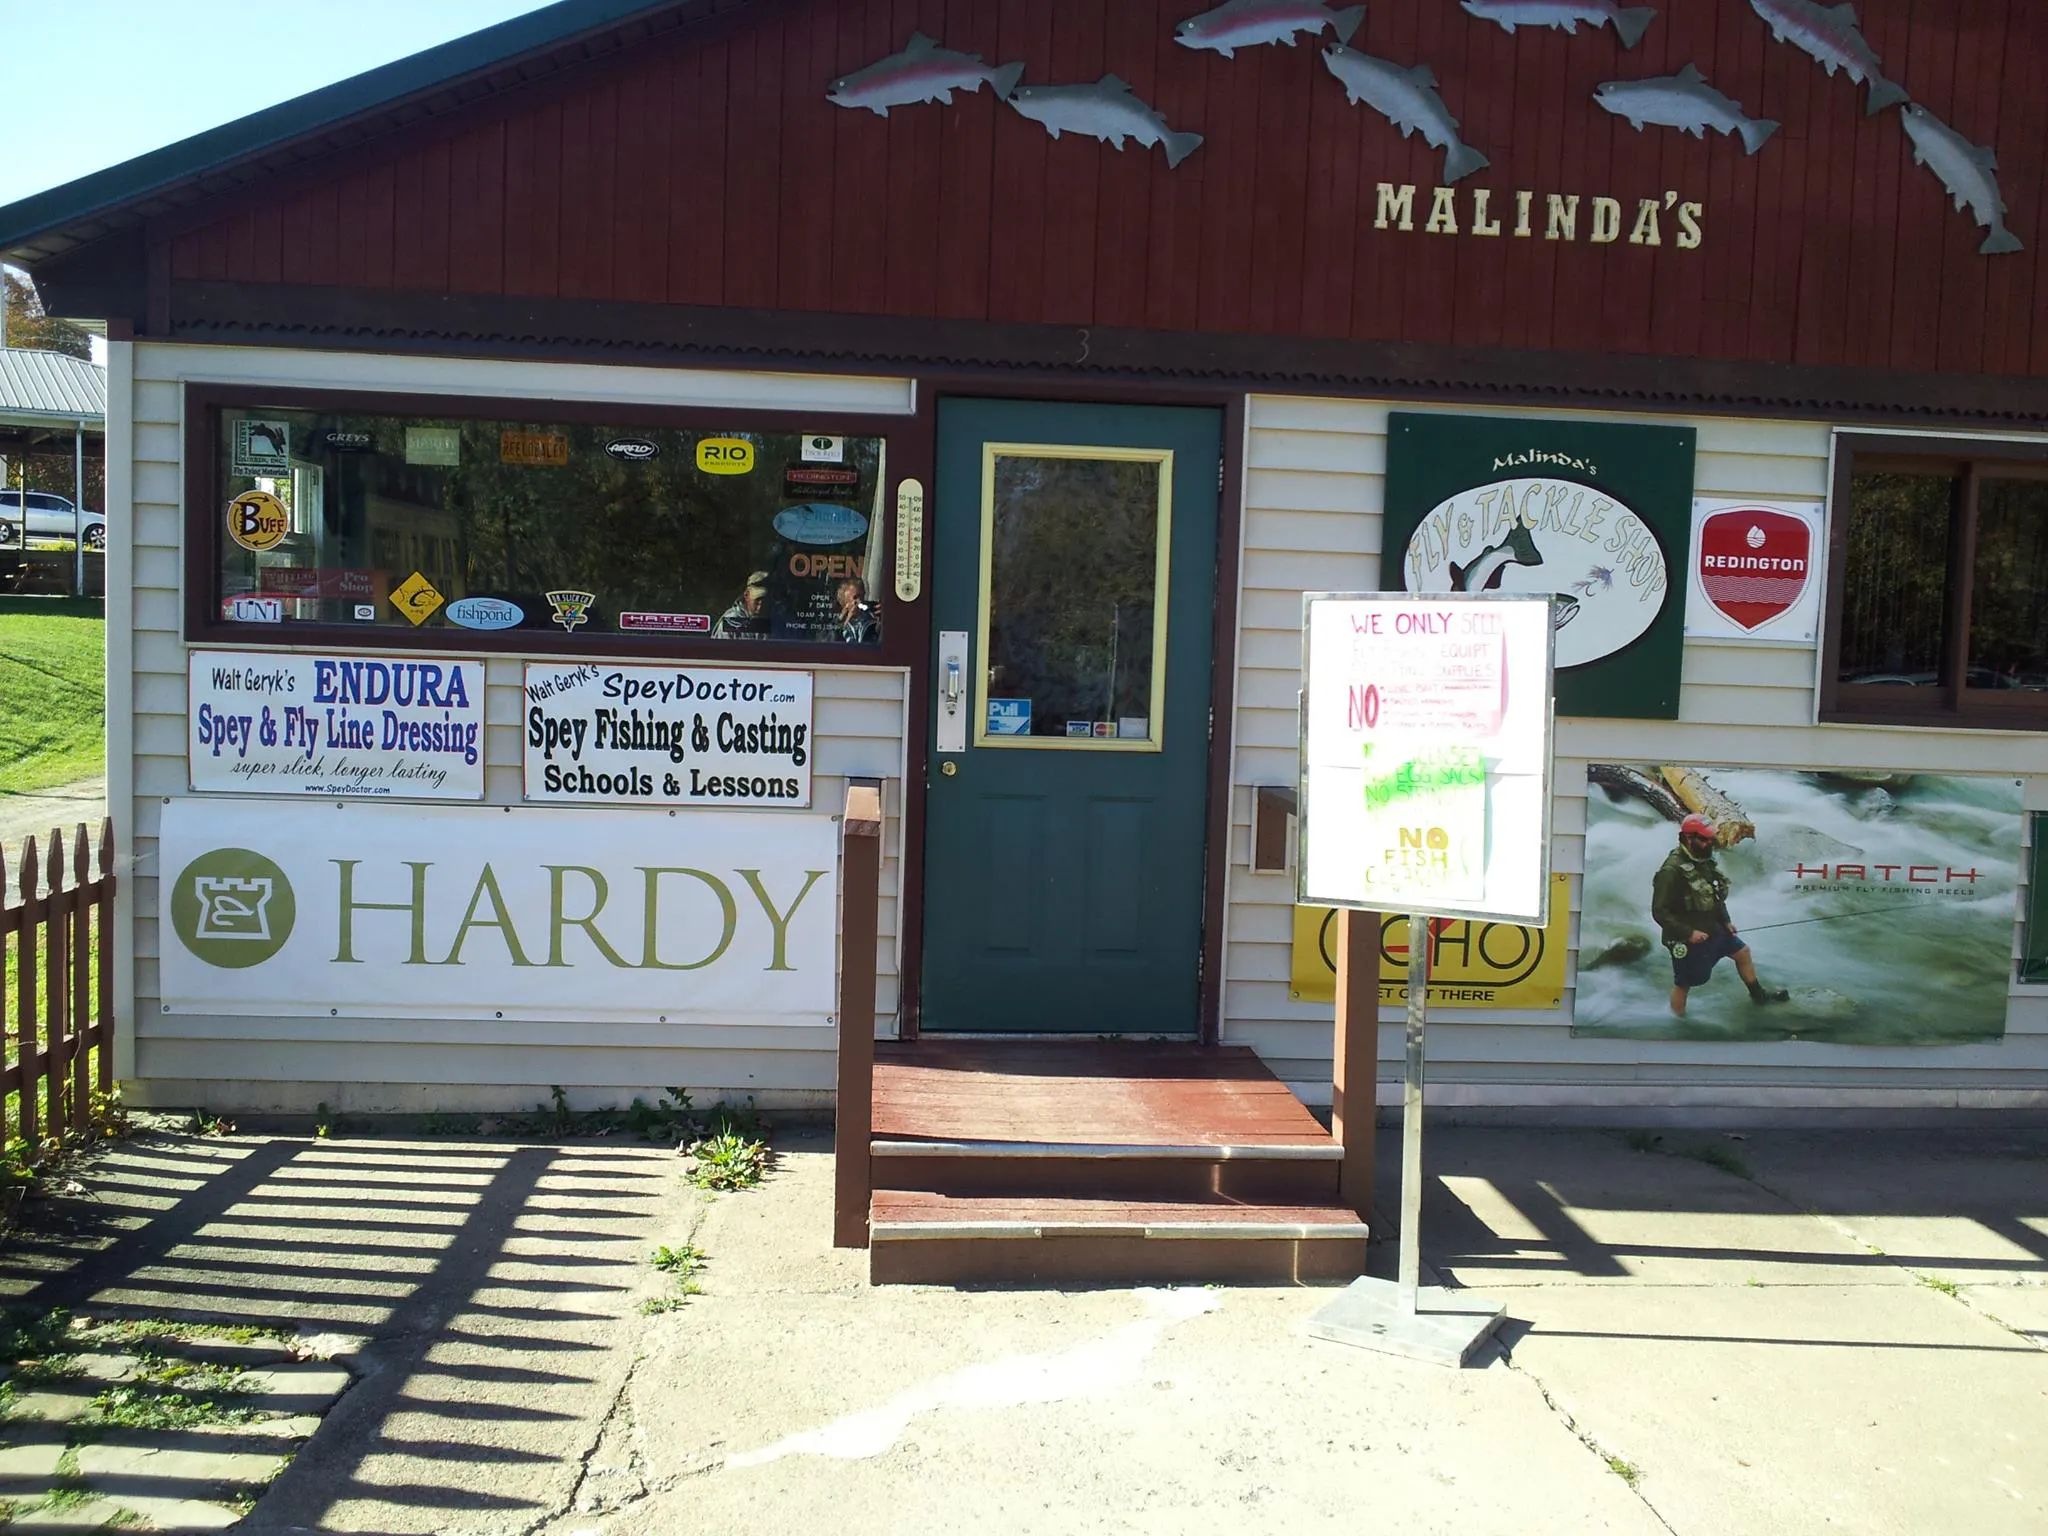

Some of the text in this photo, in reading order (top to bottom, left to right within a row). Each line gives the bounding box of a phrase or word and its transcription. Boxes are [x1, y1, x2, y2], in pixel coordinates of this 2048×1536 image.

[1373, 182, 1703, 249] MALINDA'S
[1075, 328, 1090, 364] 3
[326, 432, 370, 443] GREYS
[704, 446, 746, 460] RIO
[1492, 448, 1598, 476] Malinda's
[1408, 502, 1454, 592] FLY
[1475, 482, 1614, 545] TACKLE
[1603, 514, 1667, 603] SHOP
[789, 552, 864, 578] OPEN
[1704, 554, 1805, 572] REDINGTON
[339, 582, 373, 593] Shop
[343, 572, 368, 582] Pro
[235, 602, 279, 621] UNI
[456, 602, 512, 624] fishpond
[628, 614, 703, 624] HATCH
[1351, 613, 1384, 635] WE
[1395, 612, 1453, 635] ONLY
[212, 660, 470, 708] Walt Geryk's ENDURA
[525, 680, 555, 704] Walt
[554, 663, 600, 693] Geryk's
[989, 702, 1019, 716] Pull
[1348, 683, 1380, 732] NO
[199, 703, 478, 765] Spey & Fly Line Dressing
[528, 706, 807, 766] Spey Fishing & Casting
[230, 755, 448, 790] super slick, longer lasting
[543, 763, 799, 798] Schools & Lessons
[1399, 827, 1449, 849] NO
[1384, 849, 1448, 868] FISH
[1785, 862, 1986, 884] HATCH
[1795, 884, 1850, 893] PREMIUM
[1882, 887, 1932, 895] FISHING
[328, 858, 829, 971] HARDY
[1380, 914, 1531, 970] CHO
[1377, 987, 1495, 1001] ET OT THERE
